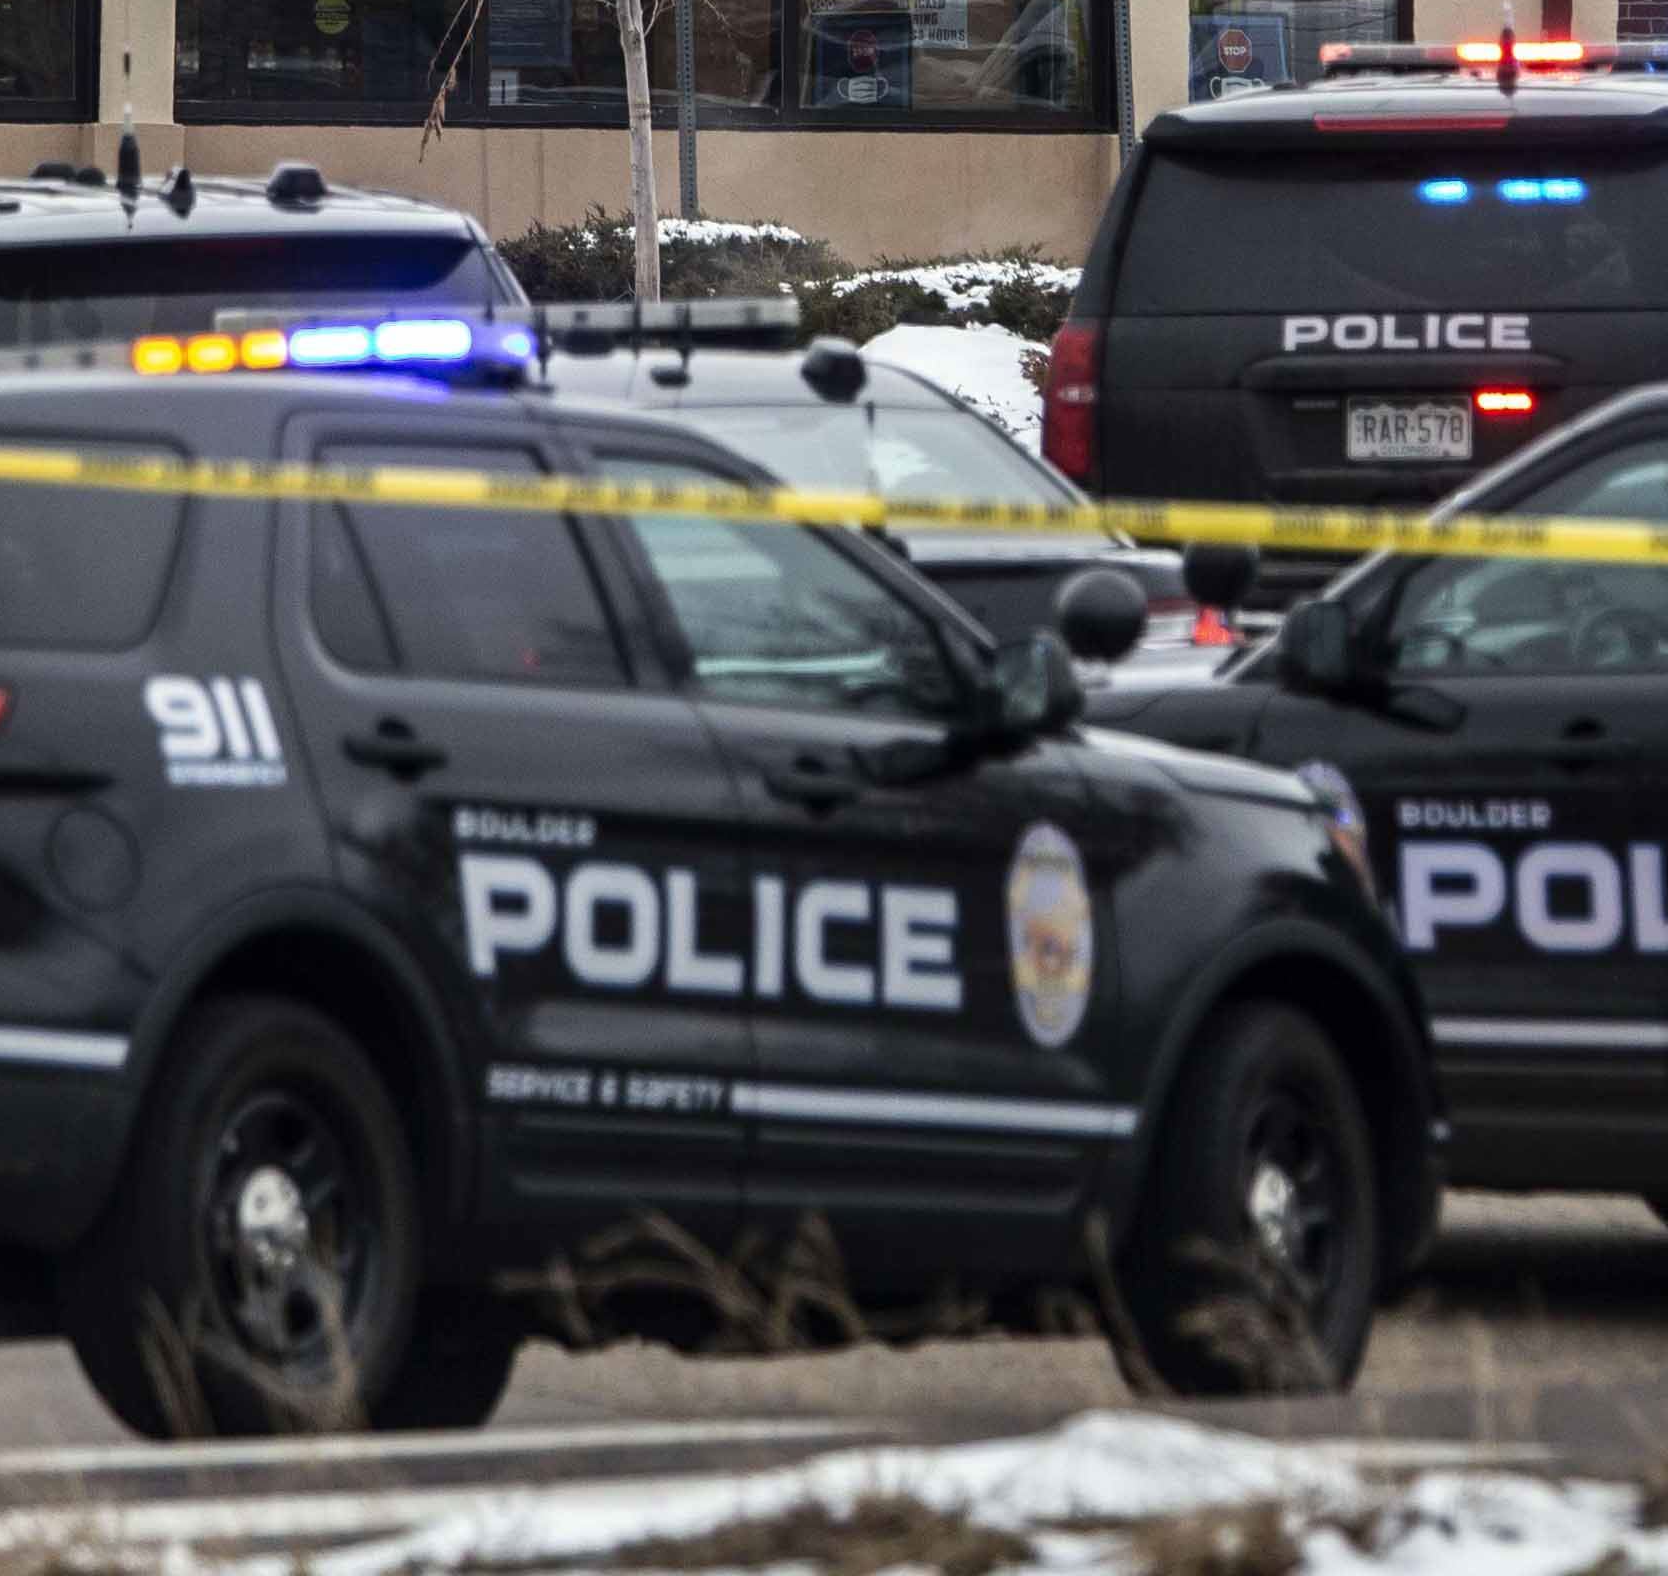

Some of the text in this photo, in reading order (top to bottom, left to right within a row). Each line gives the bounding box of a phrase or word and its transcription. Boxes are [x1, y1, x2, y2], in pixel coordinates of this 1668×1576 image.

[929, 29, 965, 42] HOURS
[1224, 47, 1246, 56] STOP
[1282, 314, 1531, 352] POLICE
[145, 676, 282, 758] 911
[452, 806, 598, 848] BOULDER
[1399, 803, 1552, 828] BOULDER
[457, 853, 965, 1012] POLICE
[486, 1063, 591, 1106] SERVICE
[628, 1075, 725, 1112] SAFETY
